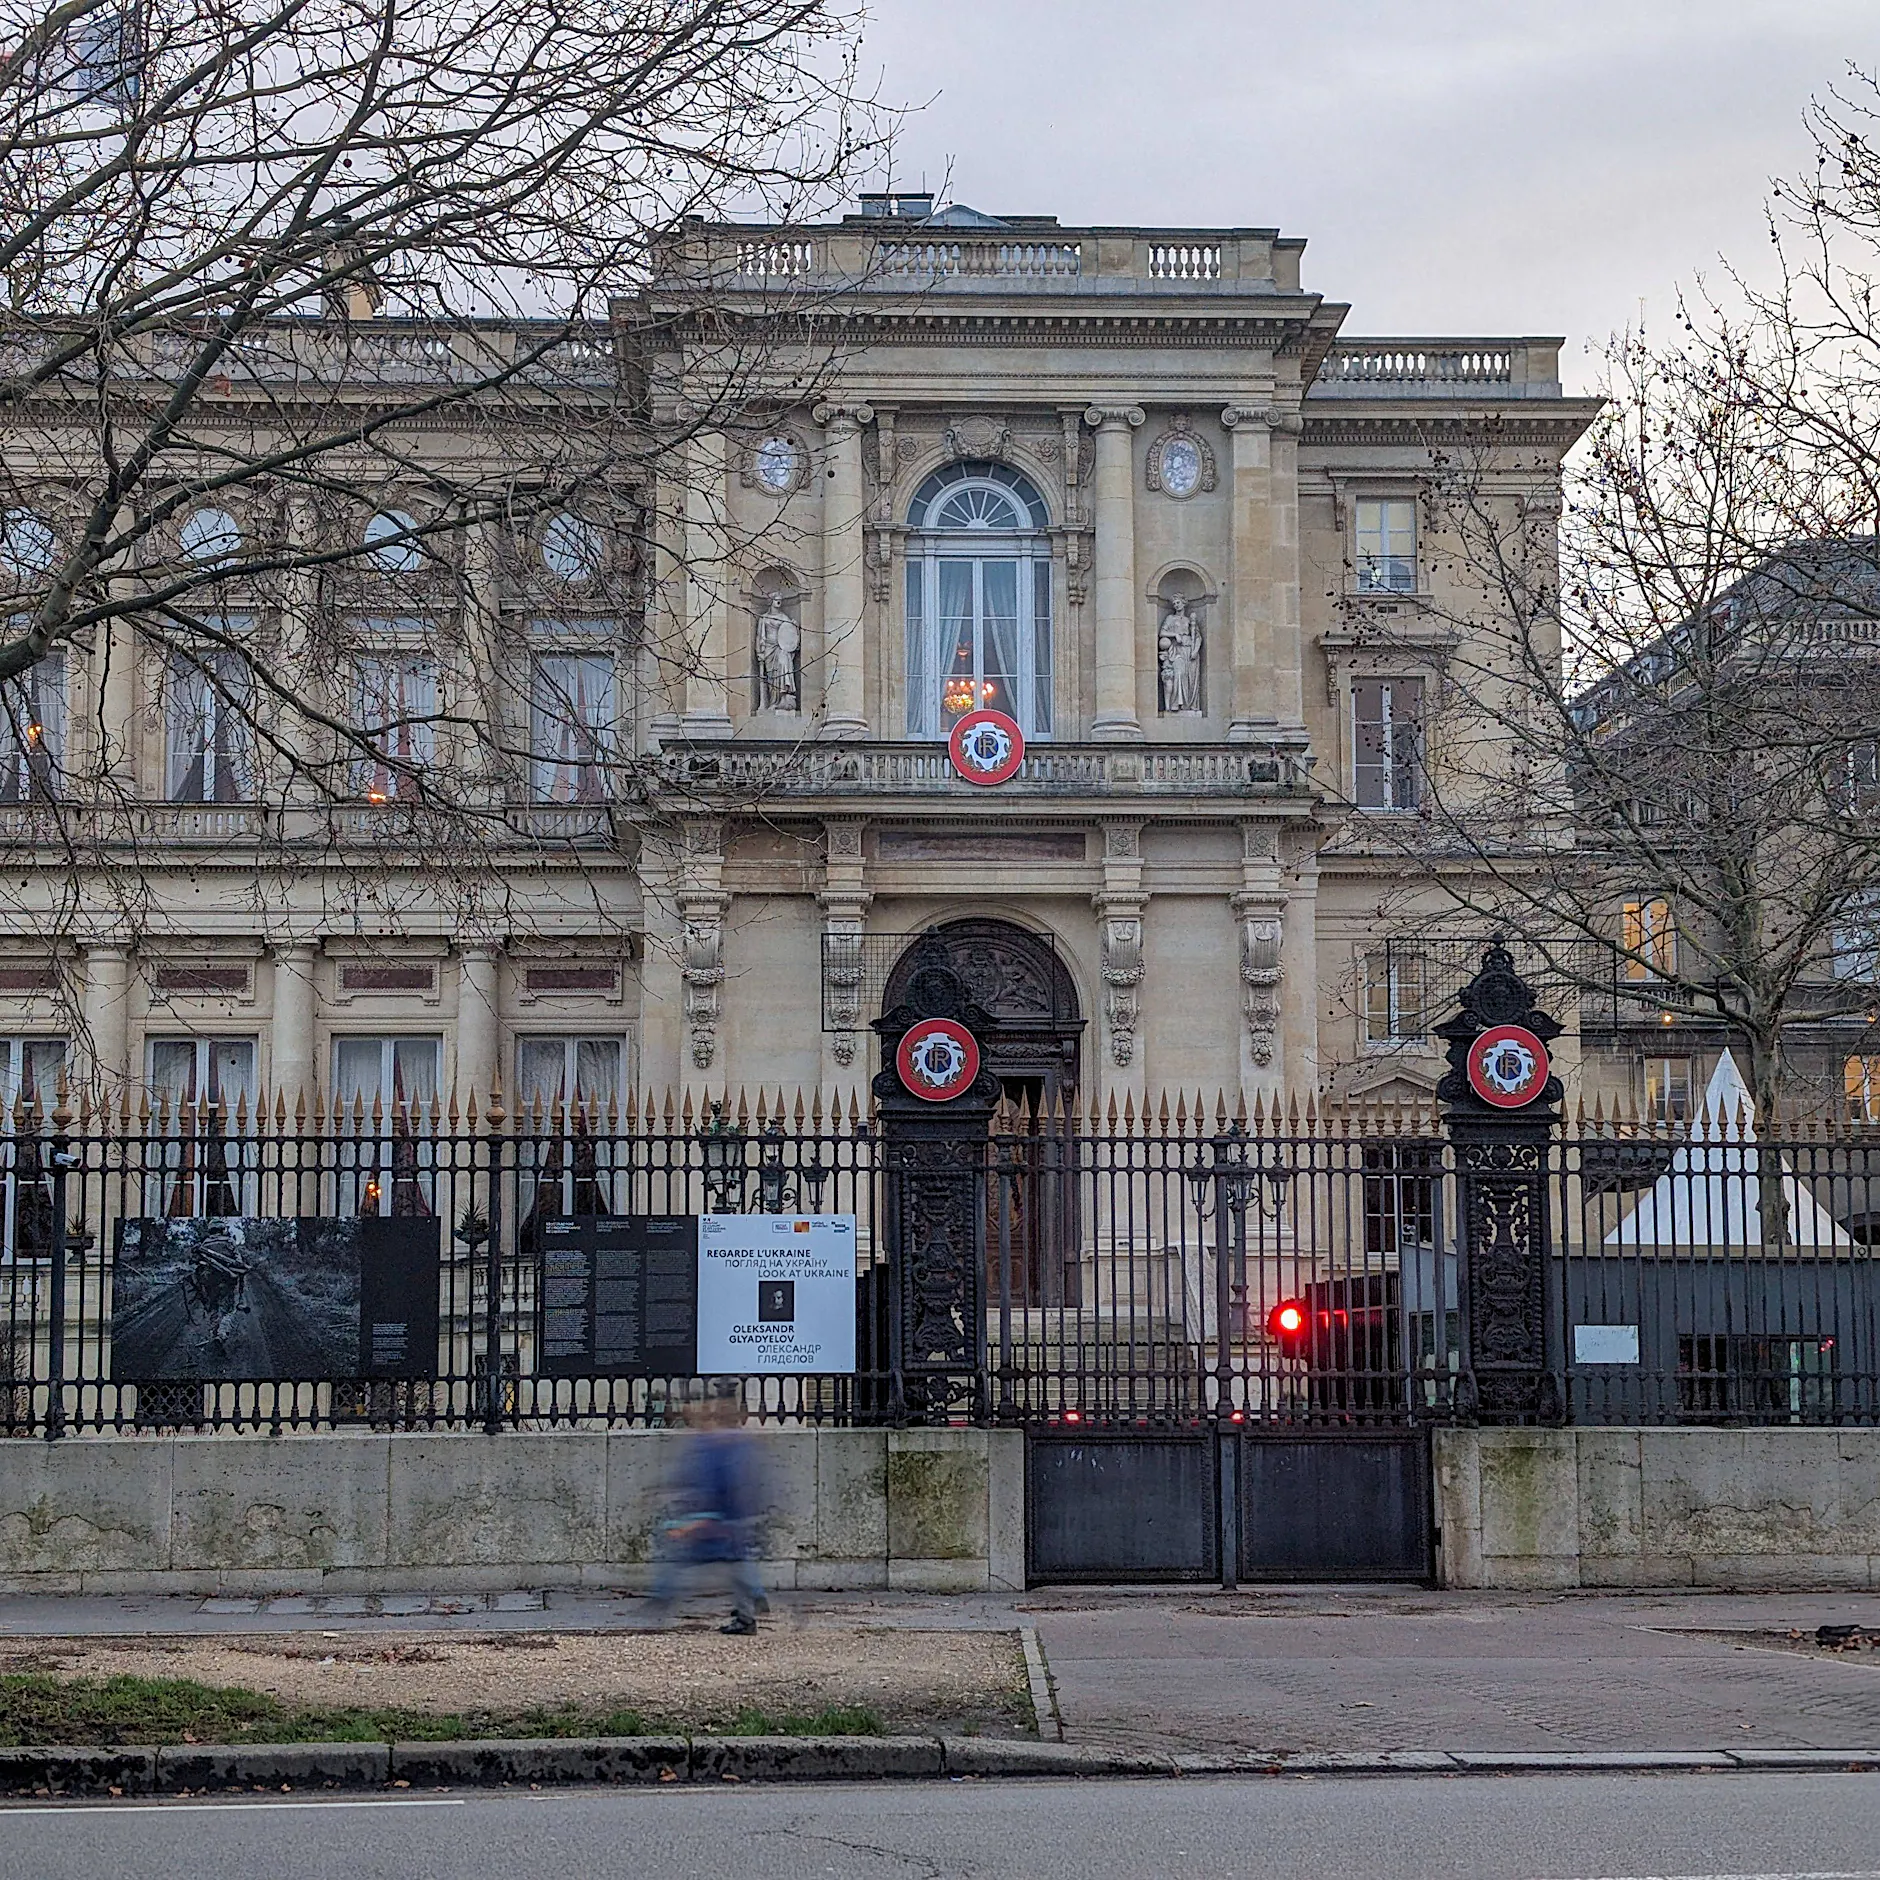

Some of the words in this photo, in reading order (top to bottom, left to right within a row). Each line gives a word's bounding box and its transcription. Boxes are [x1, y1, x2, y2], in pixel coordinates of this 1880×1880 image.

[706, 1249, 754, 1258] REGARDE
[724, 1259, 767, 1269] ПОГЛЯД
[768, 1259, 783, 1268] НА
[785, 1258, 828, 1268] УКРАЇНУ
[757, 1269, 786, 1278] LOOK
[788, 1269, 801, 1278] AT
[803, 1269, 850, 1278] UKRAINE
[732, 1325, 795, 1334] OLEKSANDR
[728, 1334, 795, 1344] GLYADYELOV
[757, 1344, 822, 1355] ОЛЕКСАНДР
[757, 1355, 815, 1365] ГЛЯДЄЛОВ
